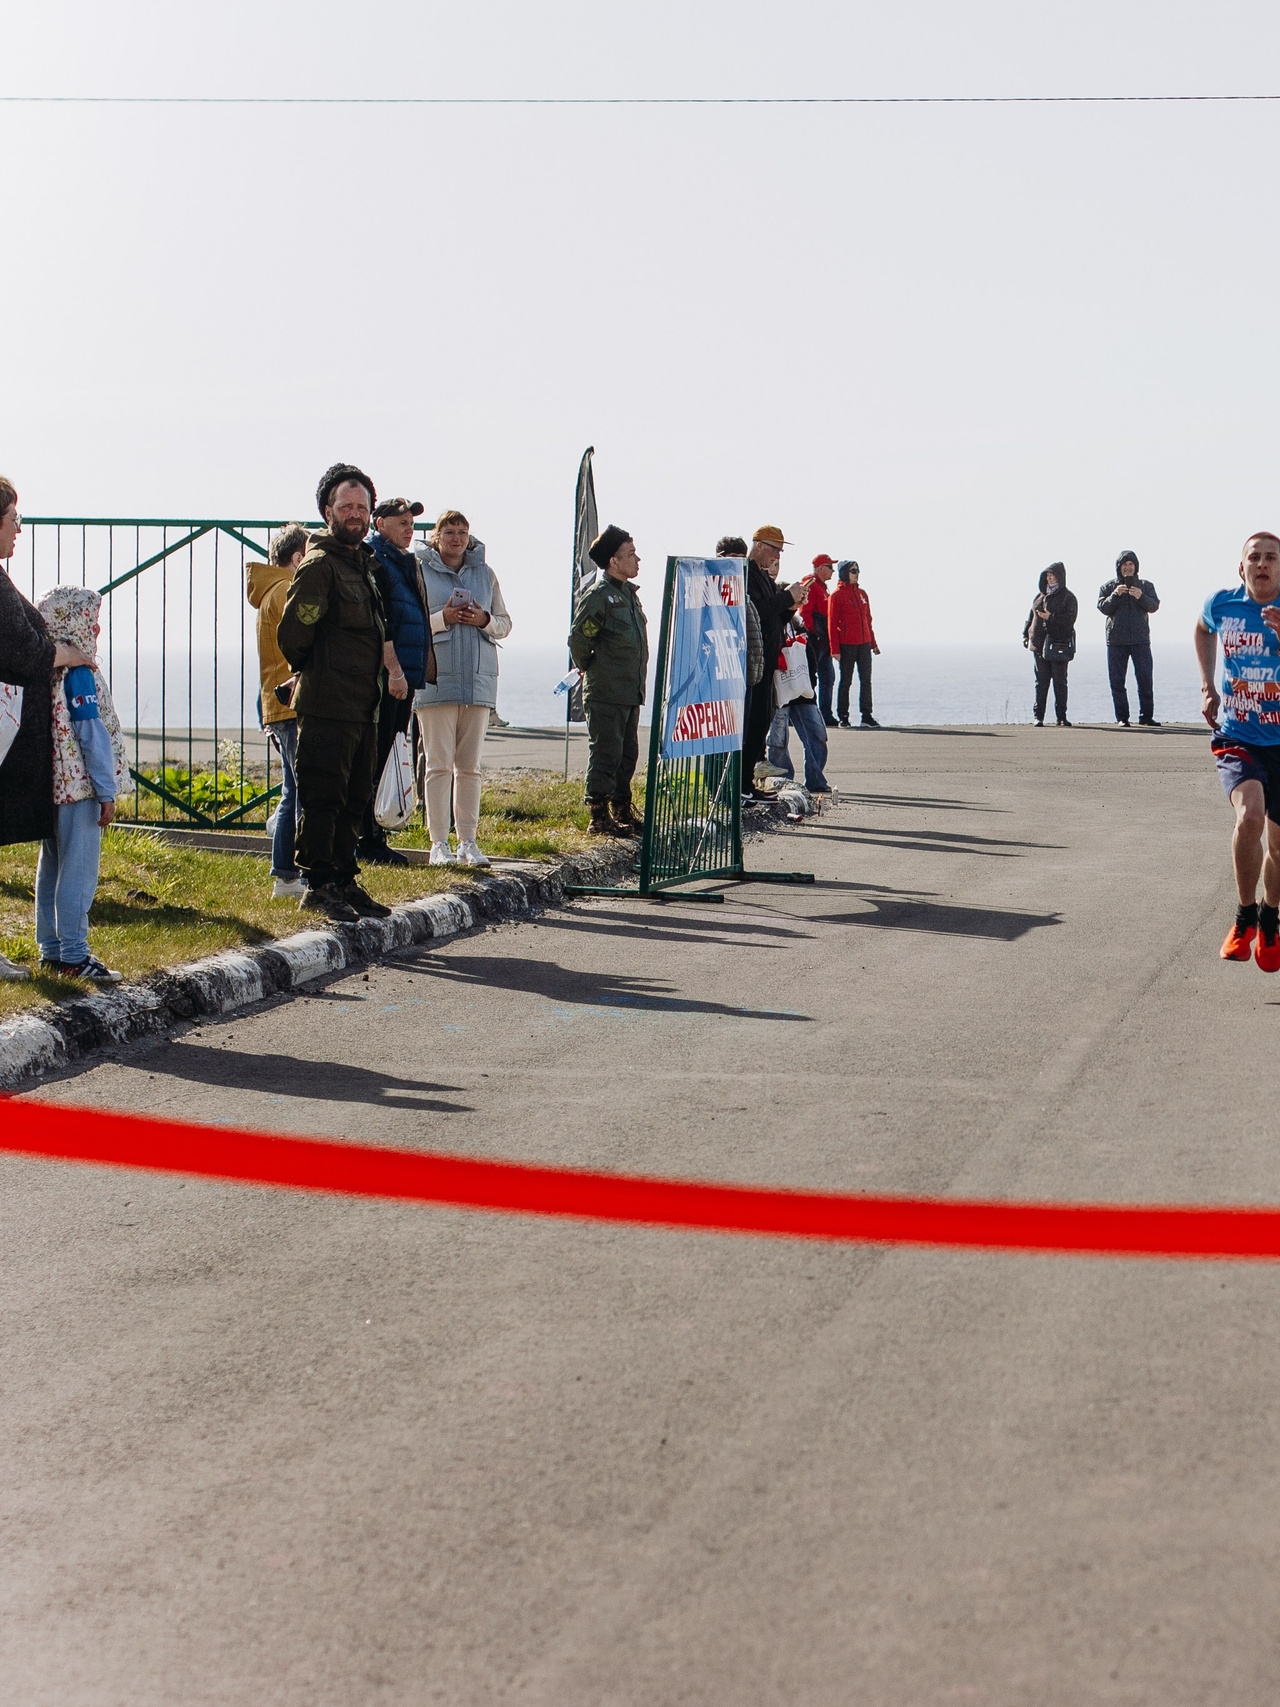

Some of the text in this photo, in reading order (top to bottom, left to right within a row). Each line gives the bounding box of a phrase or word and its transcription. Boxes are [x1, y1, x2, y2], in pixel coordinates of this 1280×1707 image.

[1221, 616, 1246, 631] 2024
[1222, 630, 1264, 647] #МЕЧТА
[1241, 666, 1274, 681] 20072
